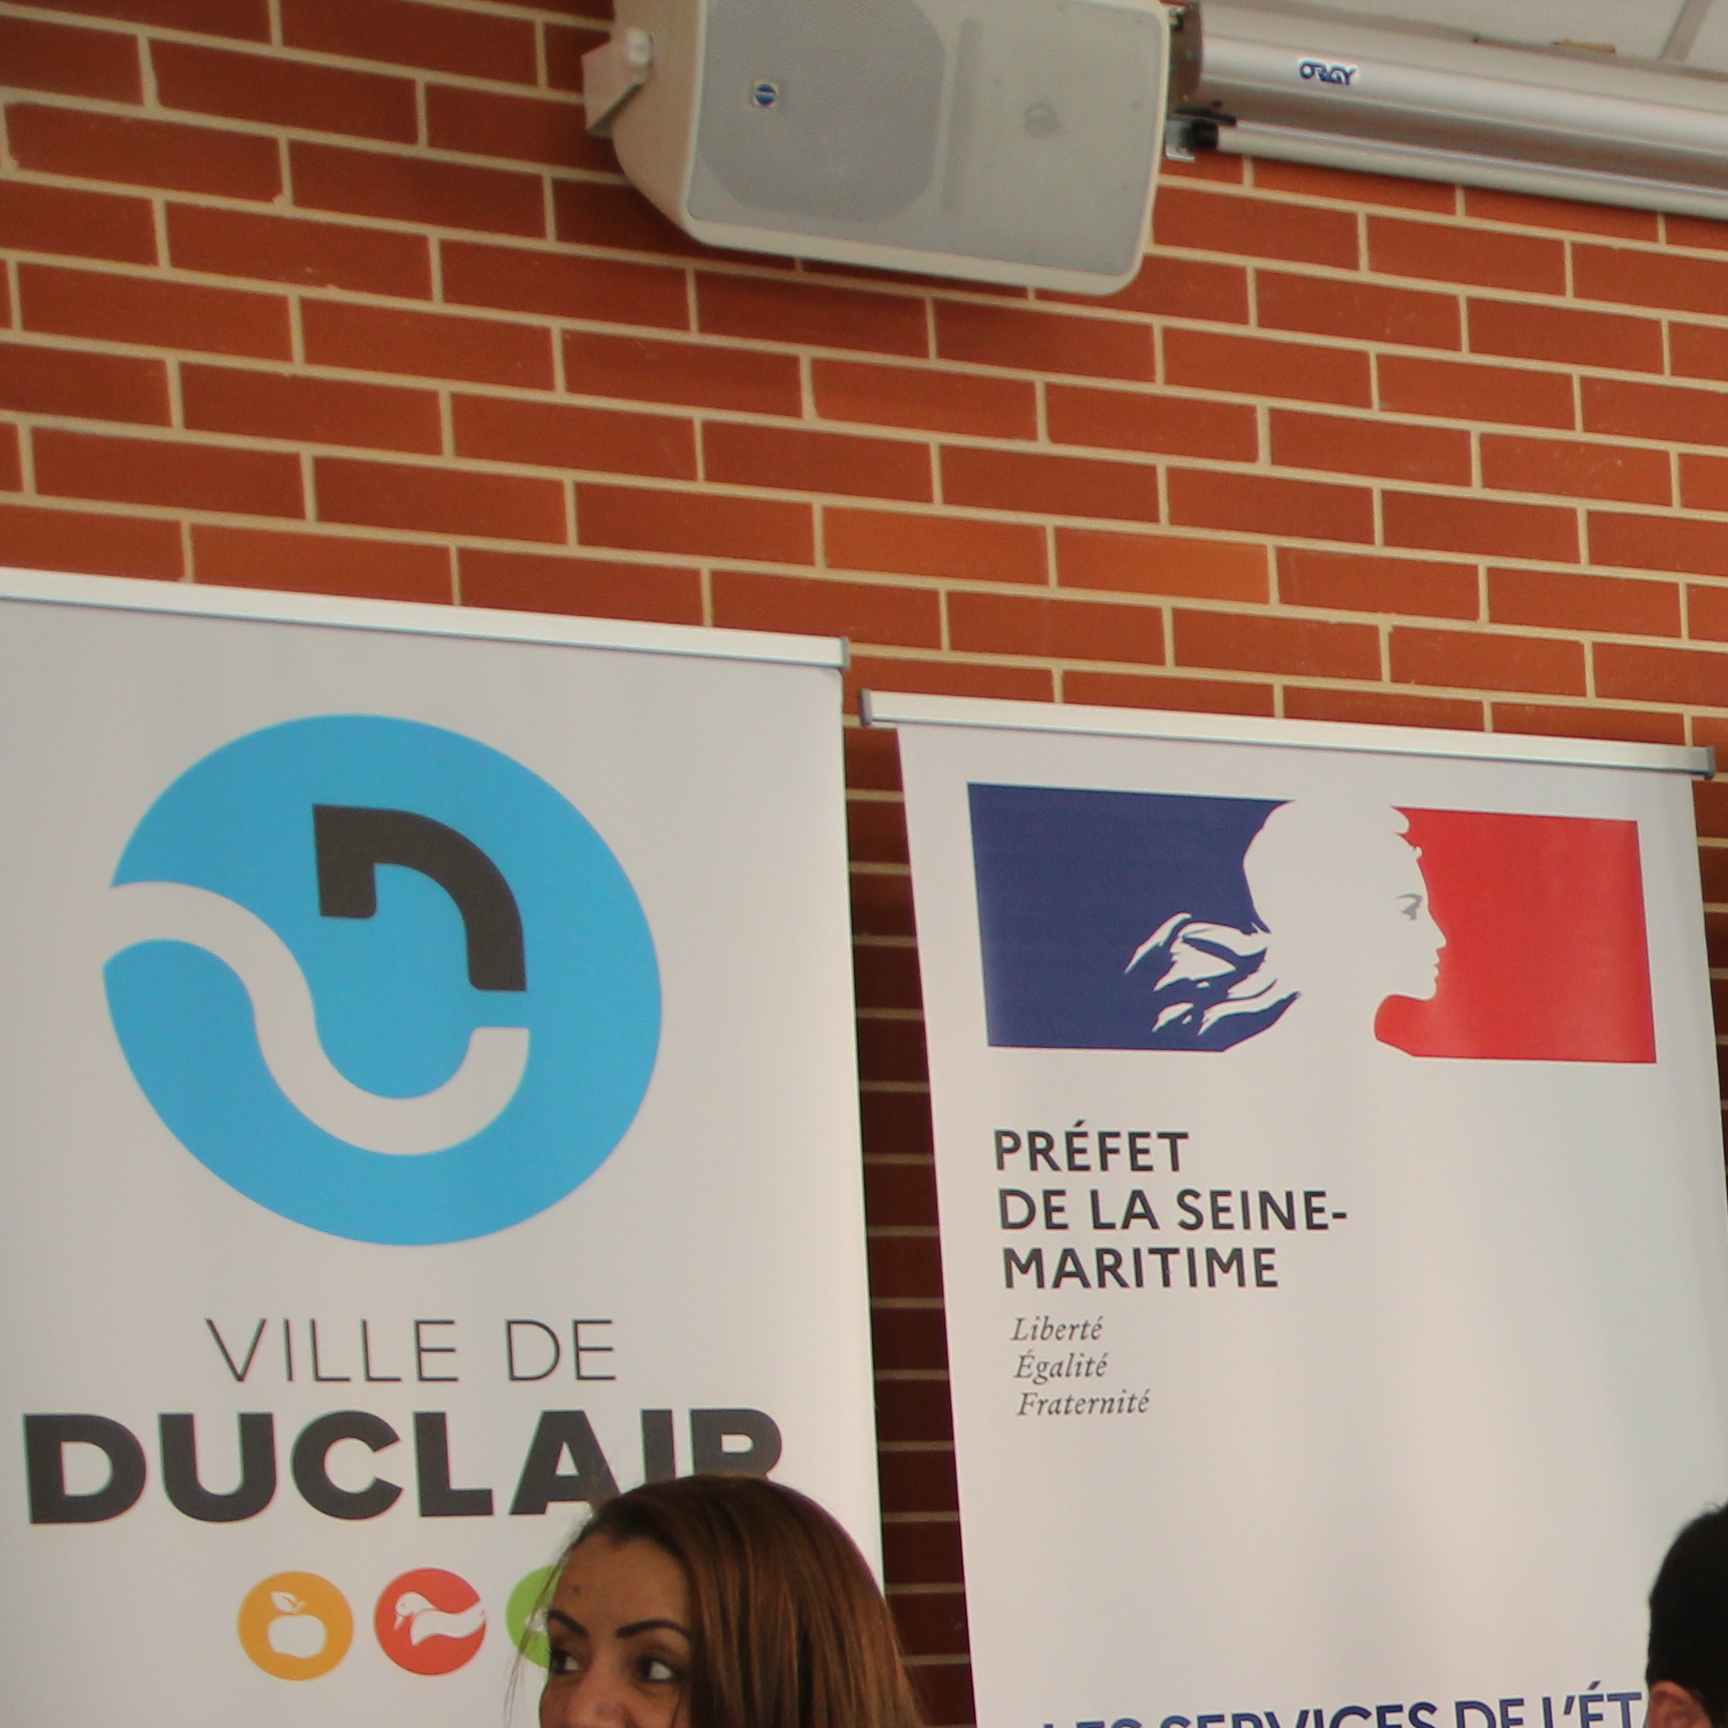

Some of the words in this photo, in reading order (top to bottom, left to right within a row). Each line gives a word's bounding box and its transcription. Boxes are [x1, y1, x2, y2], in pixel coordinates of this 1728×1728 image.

[994, 1119, 1188, 1172] PRÉFET
[998, 1188, 1069, 1230] DE
[1090, 1189, 1160, 1230] LA
[1176, 1188, 1348, 1231] SEINE-
[1002, 1247, 1279, 1289] MARITIME
[1010, 1316, 1103, 1341] Liberté
[205, 1318, 458, 1382] VILLE
[506, 1318, 617, 1381] DE
[1012, 1349, 1108, 1384] Égalité
[1015, 1389, 1150, 1415] Fraternité
[23, 1408, 783, 1525] DUCLAIR
